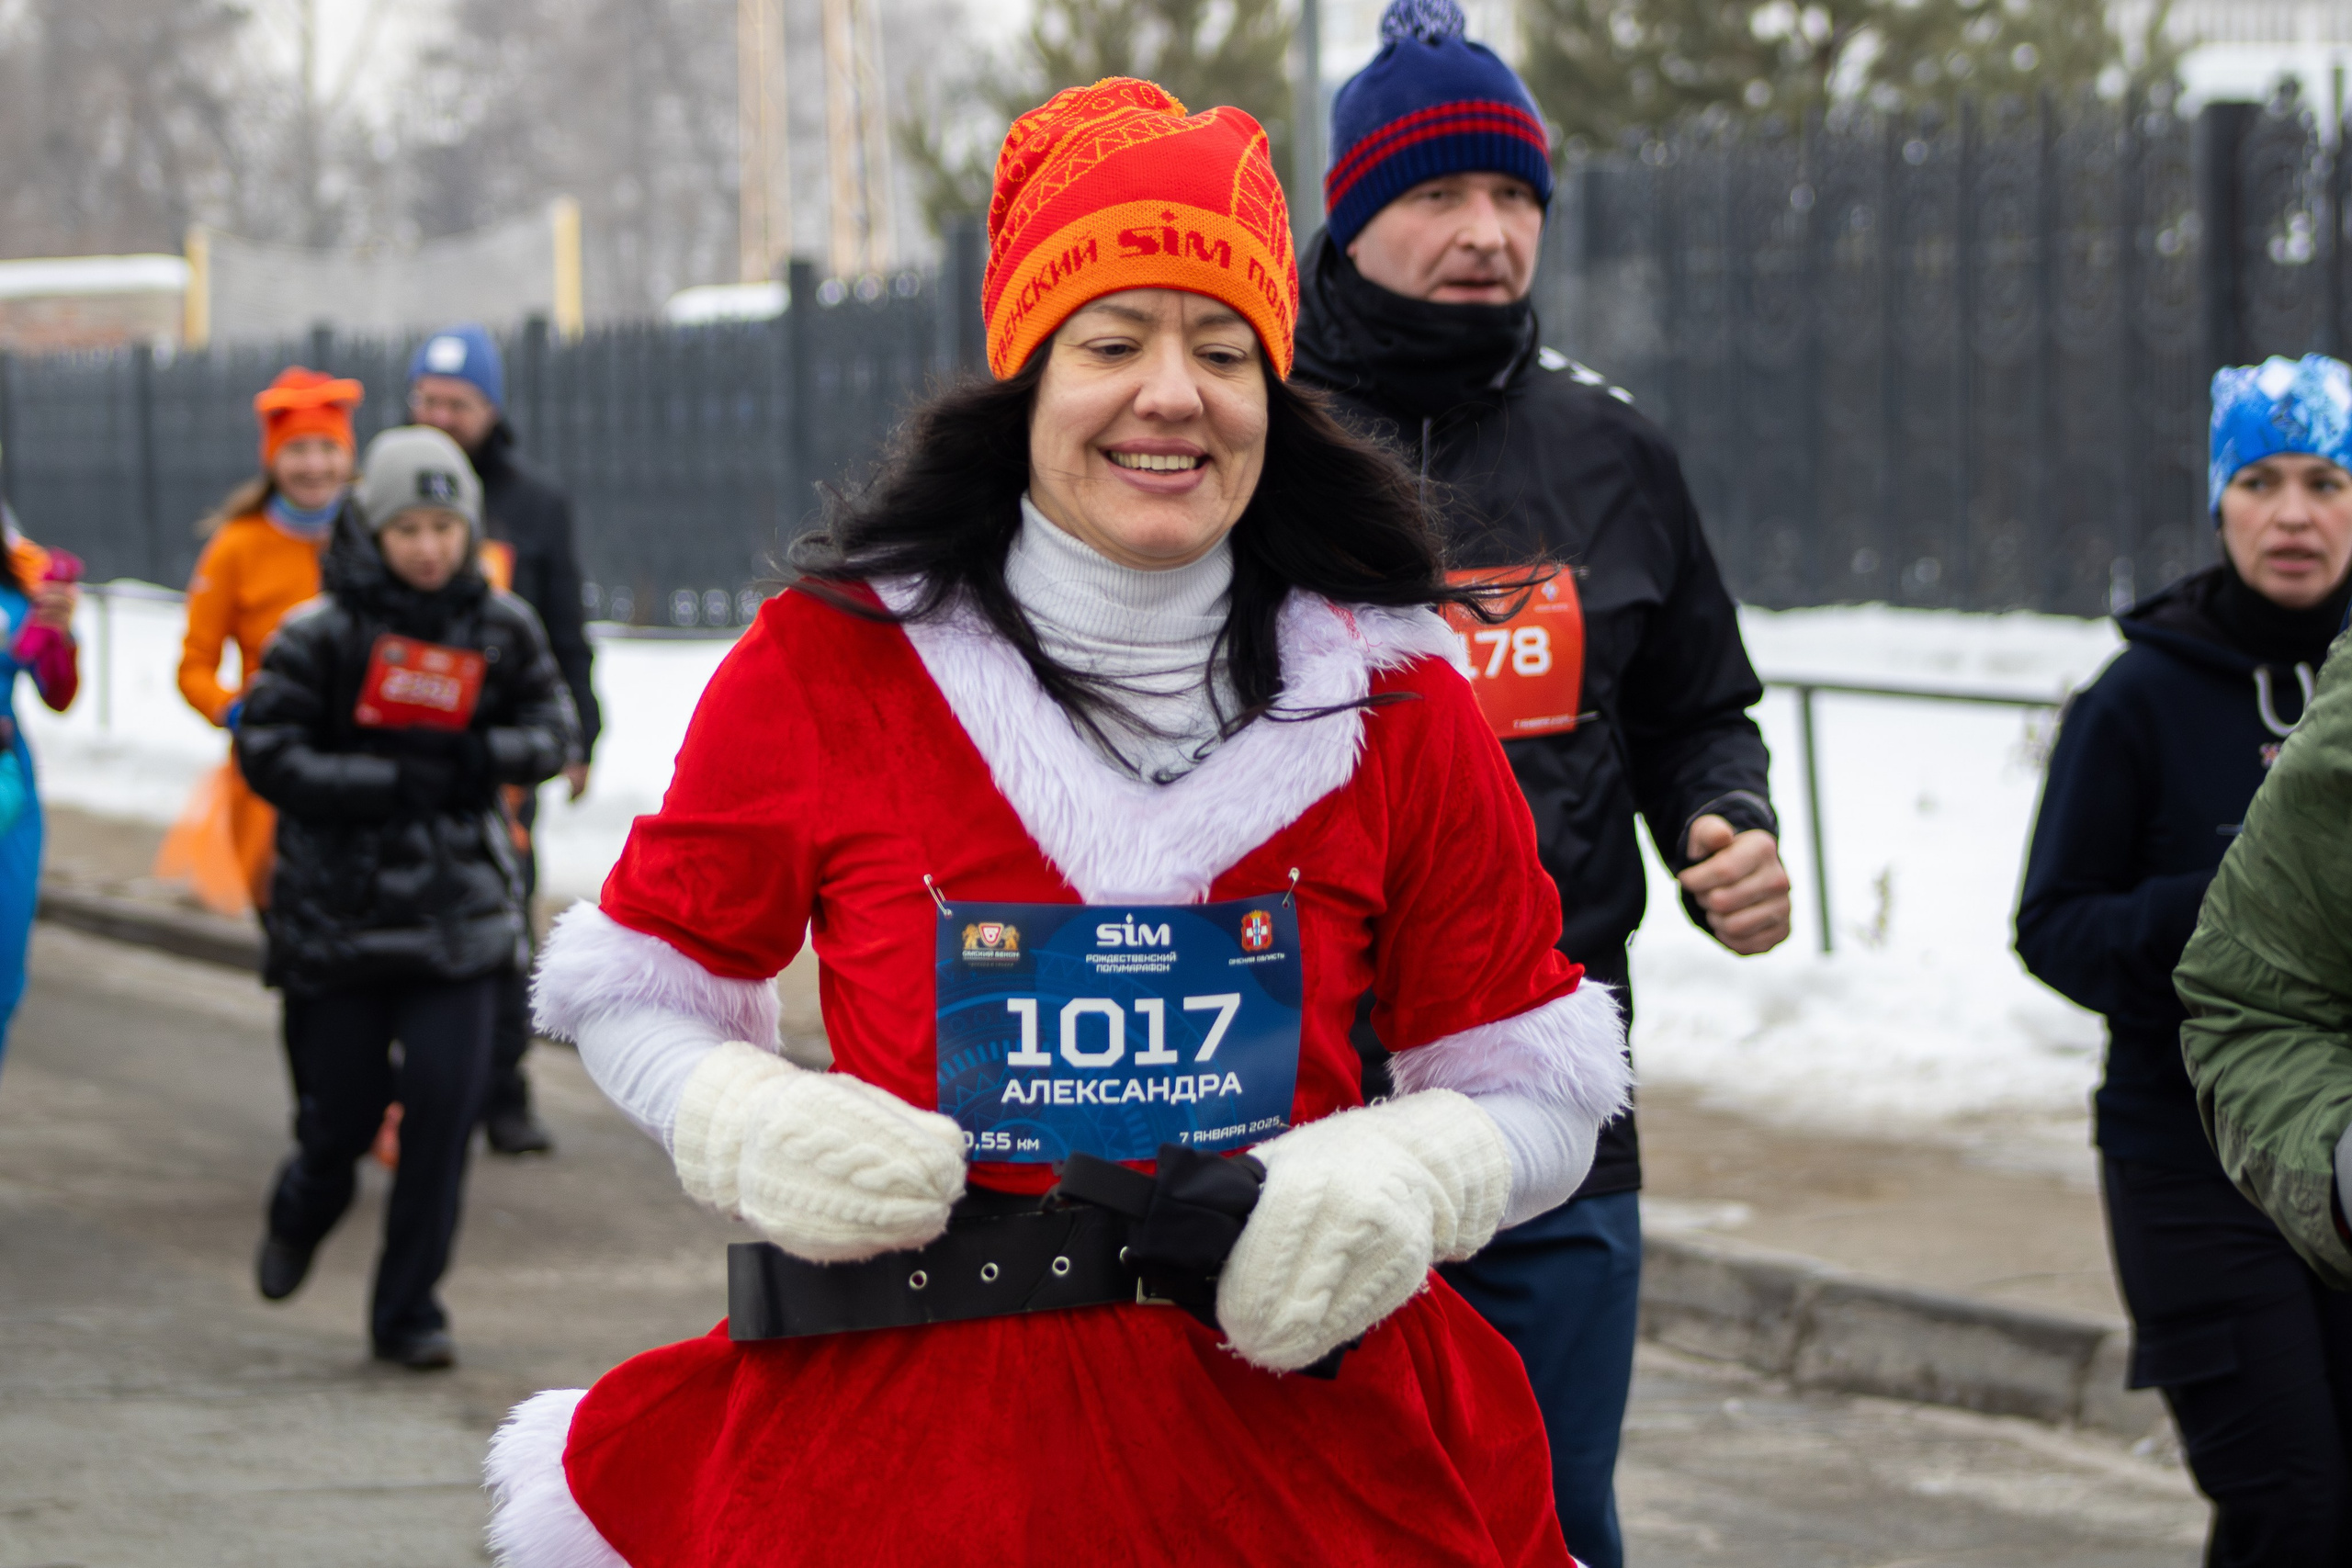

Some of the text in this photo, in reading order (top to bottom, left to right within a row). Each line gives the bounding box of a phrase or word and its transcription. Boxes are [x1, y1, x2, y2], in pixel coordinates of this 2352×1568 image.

[1086, 952, 1177, 964] РОЖДЕСТВЕНСКИЙ
[1096, 964, 1170, 973] ПОЛУМАРАФОН
[1007, 993, 1240, 1067] 1017
[1001, 1071, 1243, 1104] АЛЕКСАНДРА
[1180, 1115, 1281, 1144] 7 ЯНВАРЯ 2025
